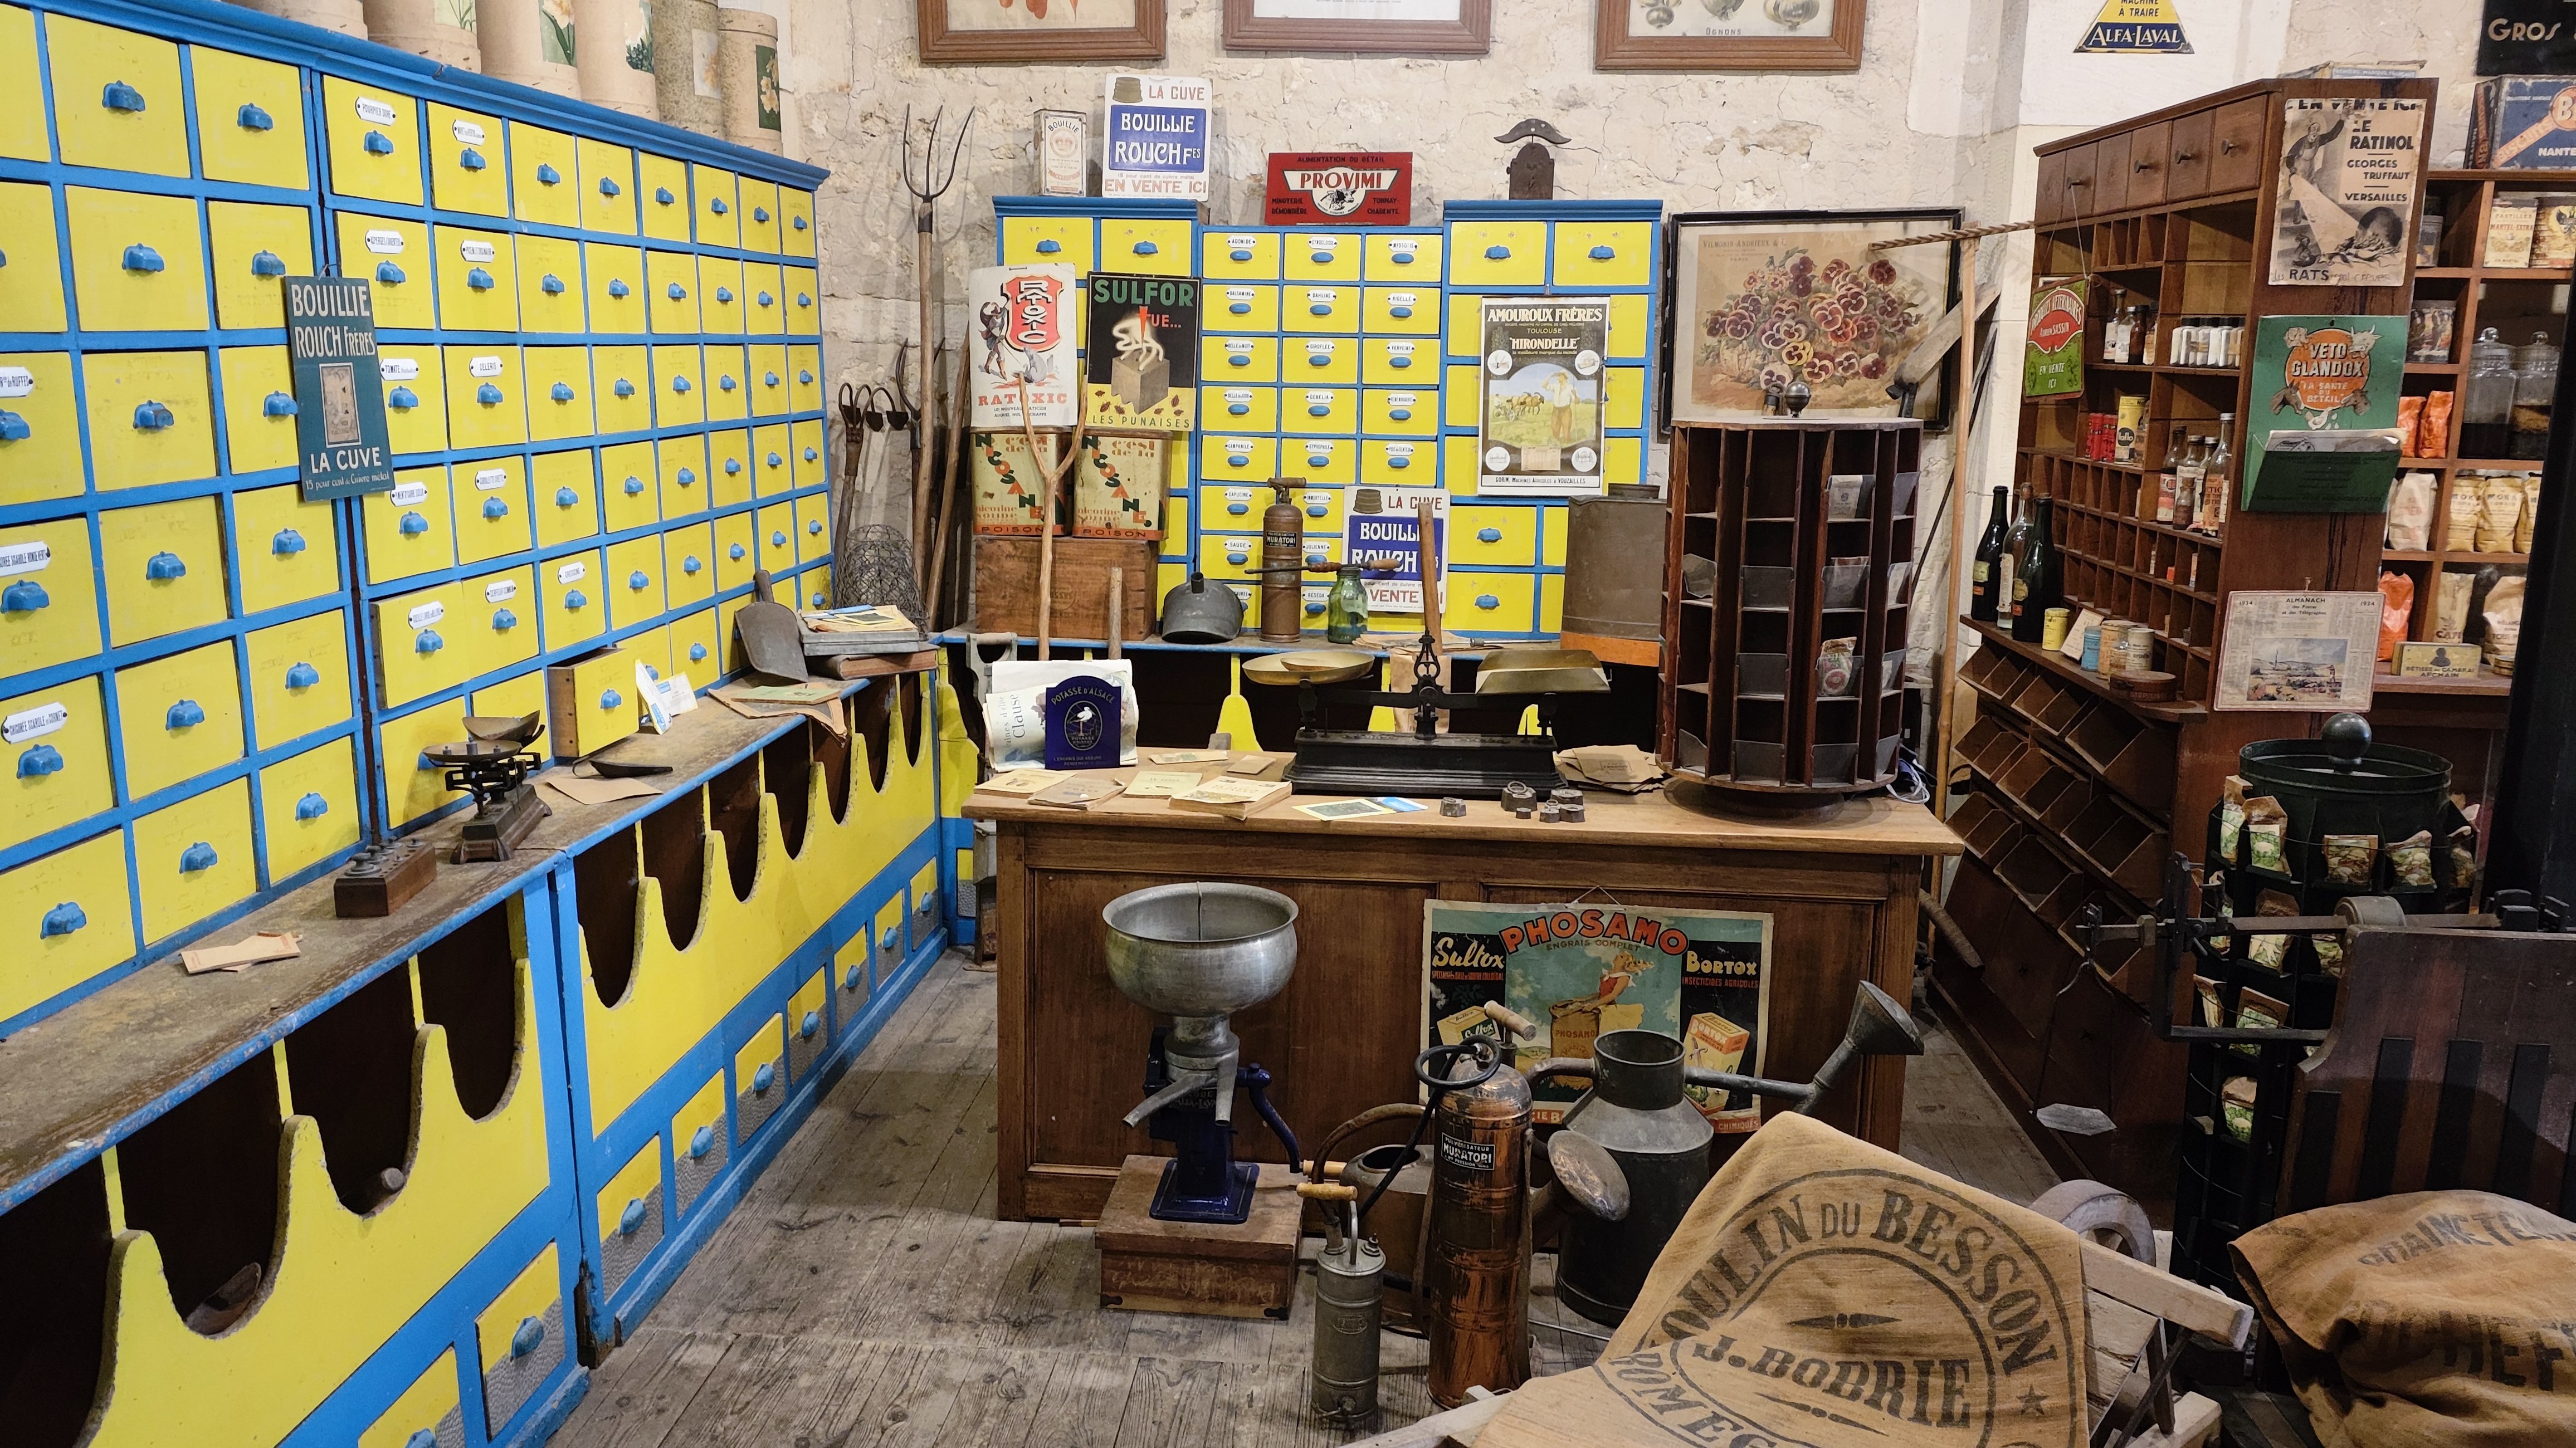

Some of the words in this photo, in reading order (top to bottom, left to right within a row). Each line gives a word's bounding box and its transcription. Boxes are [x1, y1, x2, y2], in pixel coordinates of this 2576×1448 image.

[2129, 8, 2160, 17] TRAIRE
[2089, 26, 2181, 47] ALFA-LAVAL
[2488, 18, 2562, 41] GROS
[1149, 85, 1164, 99] LA
[1171, 86, 1204, 101] CUVE
[1048, 120, 1080, 133] BOUILLIE
[1121, 112, 1196, 133] BOUILLIE
[2350, 135, 2414, 150] RATINOL
[1115, 141, 1182, 165] ROUCH
[2347, 159, 2398, 168] GEORGES
[1300, 172, 1382, 189] PROVIMI
[2363, 172, 2410, 180] TRUFFAUT
[1105, 178, 1125, 192] EN
[1132, 179, 1182, 193] VENTE
[1189, 180, 1207, 194] ICI
[2345, 193, 2408, 202] VERSAILLES
[2290, 269, 2330, 281] RATS
[291, 283, 370, 317] BOUILLIE
[1094, 279, 1194, 307] SULFOR
[1487, 308, 1553, 322] AMOUROUX
[1554, 306, 1603, 322] FRÈRES
[295, 325, 343, 358] ROUCH
[343, 328, 375, 357] FRÈRES
[2311, 343, 2347, 360] VETO
[384, 365, 400, 374] TOMATE
[2048, 362, 2065, 375] VENTE
[2292, 360, 2365, 377] GLANDOX
[978, 393, 1067, 407] RATXIC
[1122, 415, 1190, 428] PUNAISES
[310, 452, 330, 474] LA
[335, 446, 382, 469] CUVE
[305, 480, 313, 490] 15
[315, 480, 330, 491] pour
[331, 476, 344, 486] cent
[350, 473, 370, 485] Cuivre
[1388, 495, 1403, 509] LA
[1082, 529, 1146, 537] POISON
[1360, 522, 1420, 541] BOUILLI
[1267, 536, 1296, 544] MURATORI
[1370, 589, 1419, 603] VENTE
[1051, 686, 1082, 706] POTASSE
[1009, 694, 1026, 738] Clause
[1498, 908, 1689, 956] PHOSAMO
[1545, 939, 1591, 951] ENGRAIS
[1432, 937, 1505, 970] Sultox
[1687, 950, 1757, 976] BORTOX
[1682, 976, 1723, 987] INSECTICIDES
[1724, 979, 1759, 989] AGRICOLES
[1555, 1029, 1596, 1038] PHOSAMO
[1443, 1142, 1492, 1163] MURATORI
[1653, 1193, 1813, 1343] OULIN
[1821, 1202, 1861, 1239] DU
[1870, 1188, 2058, 1376] BESSON
